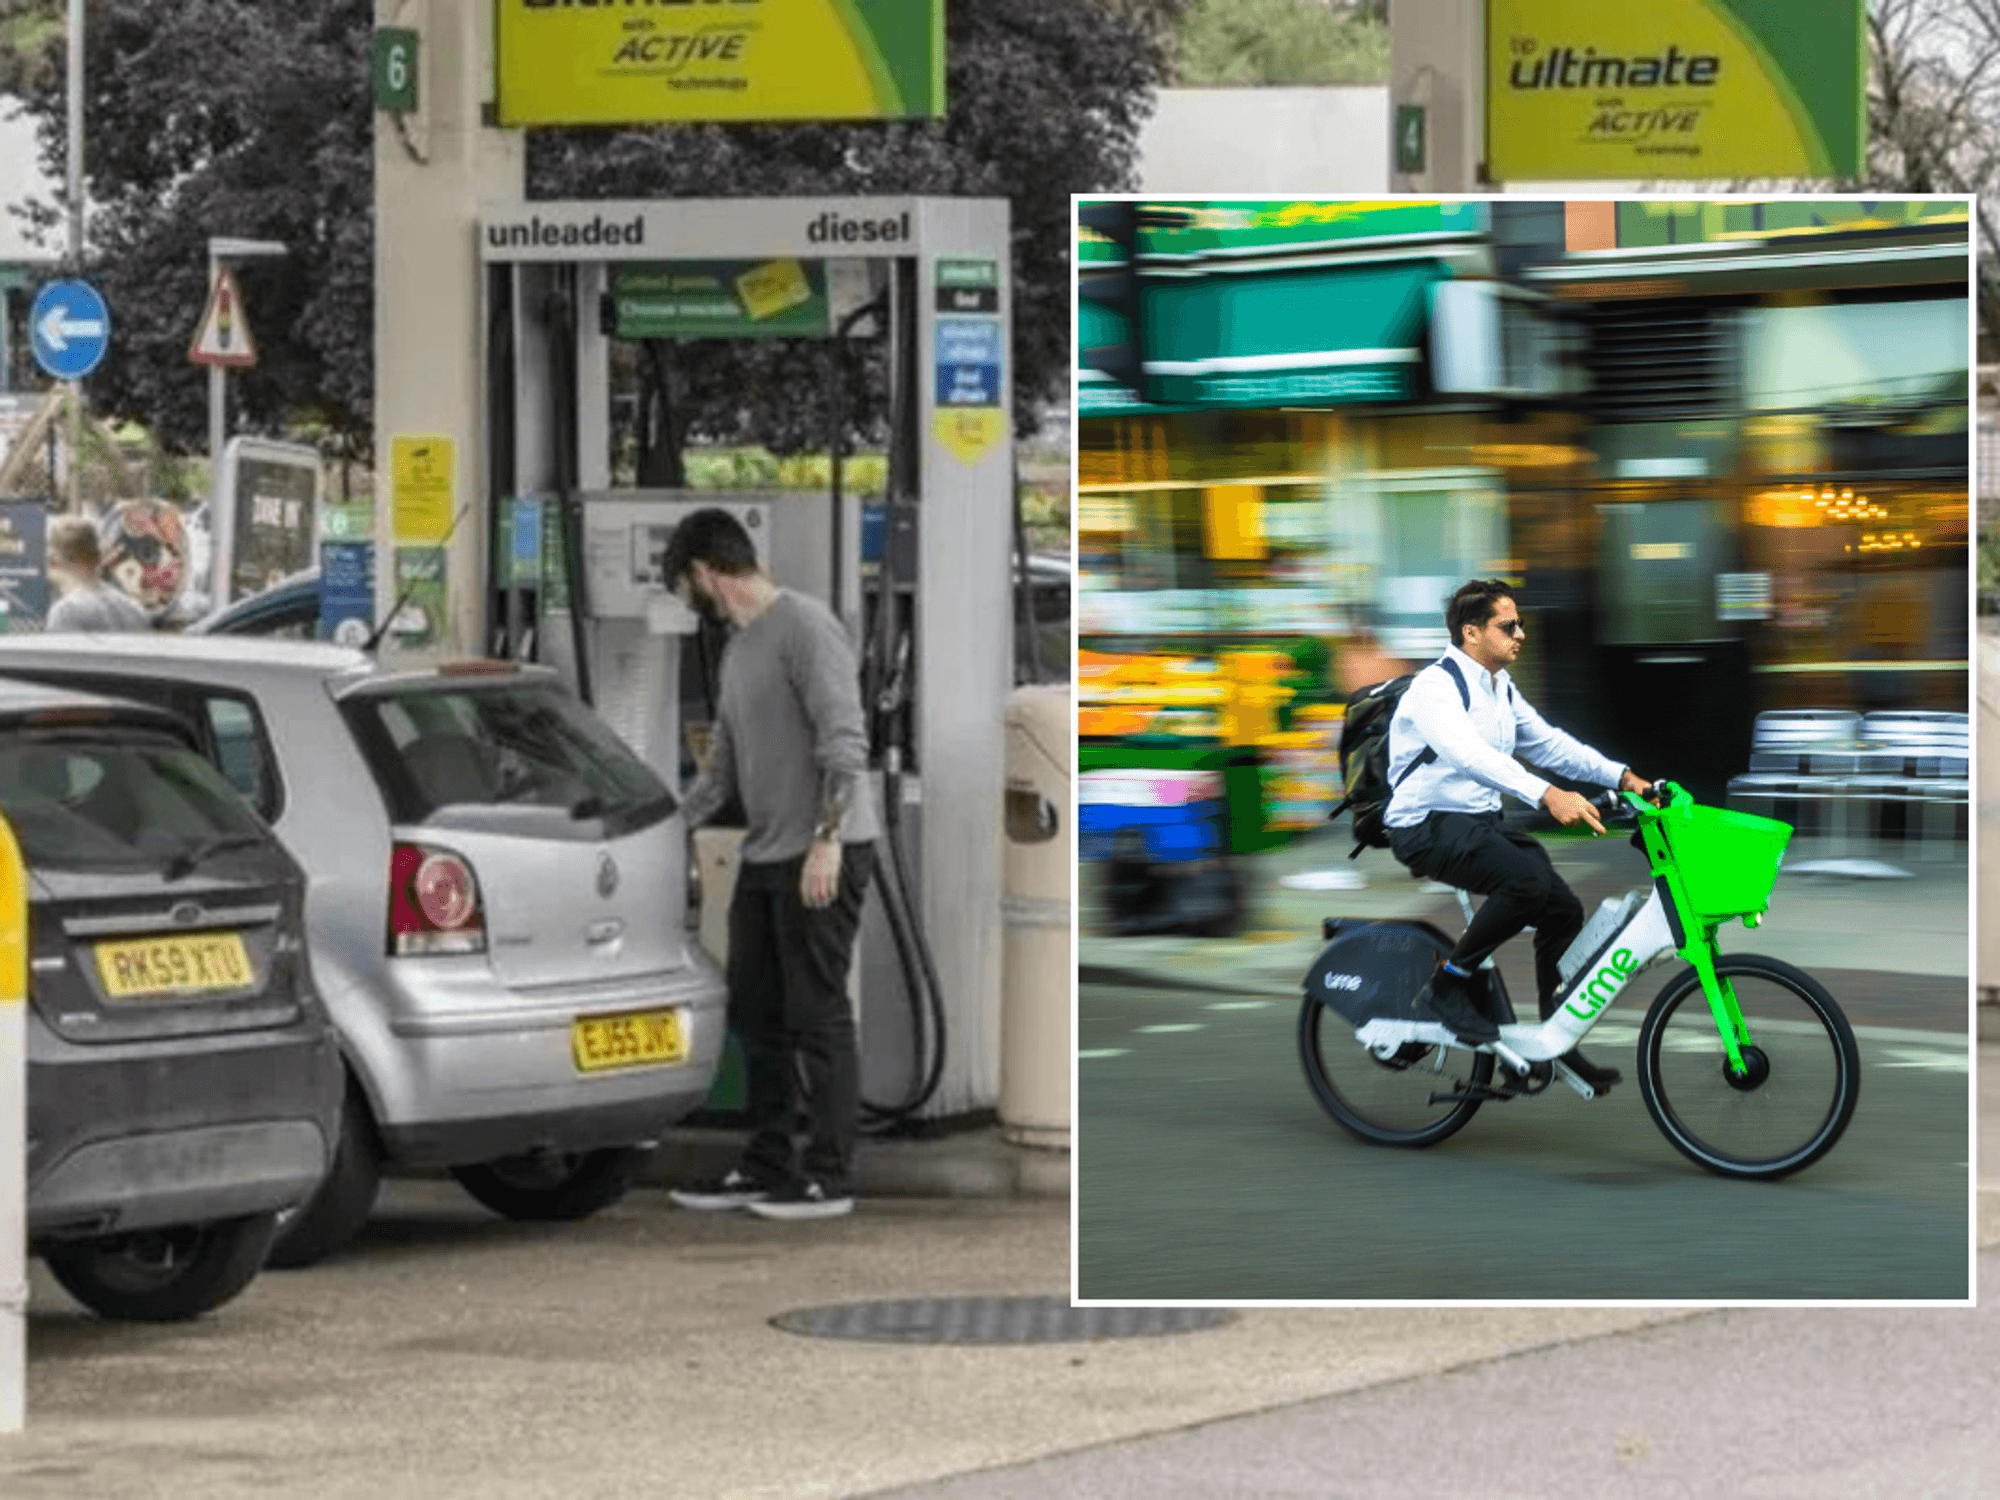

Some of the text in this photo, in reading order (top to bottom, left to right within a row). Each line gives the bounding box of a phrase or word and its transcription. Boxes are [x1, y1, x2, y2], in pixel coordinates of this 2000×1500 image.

[613, 34, 748, 63] ACTIVE
[387, 44, 407, 91] 6
[1509, 45, 1720, 89] ultimate
[1588, 110, 1700, 134] ACTIVE
[1403, 120, 1419, 157] 4
[488, 216, 645, 247] unleaded
[806, 212, 911, 242] diesel
